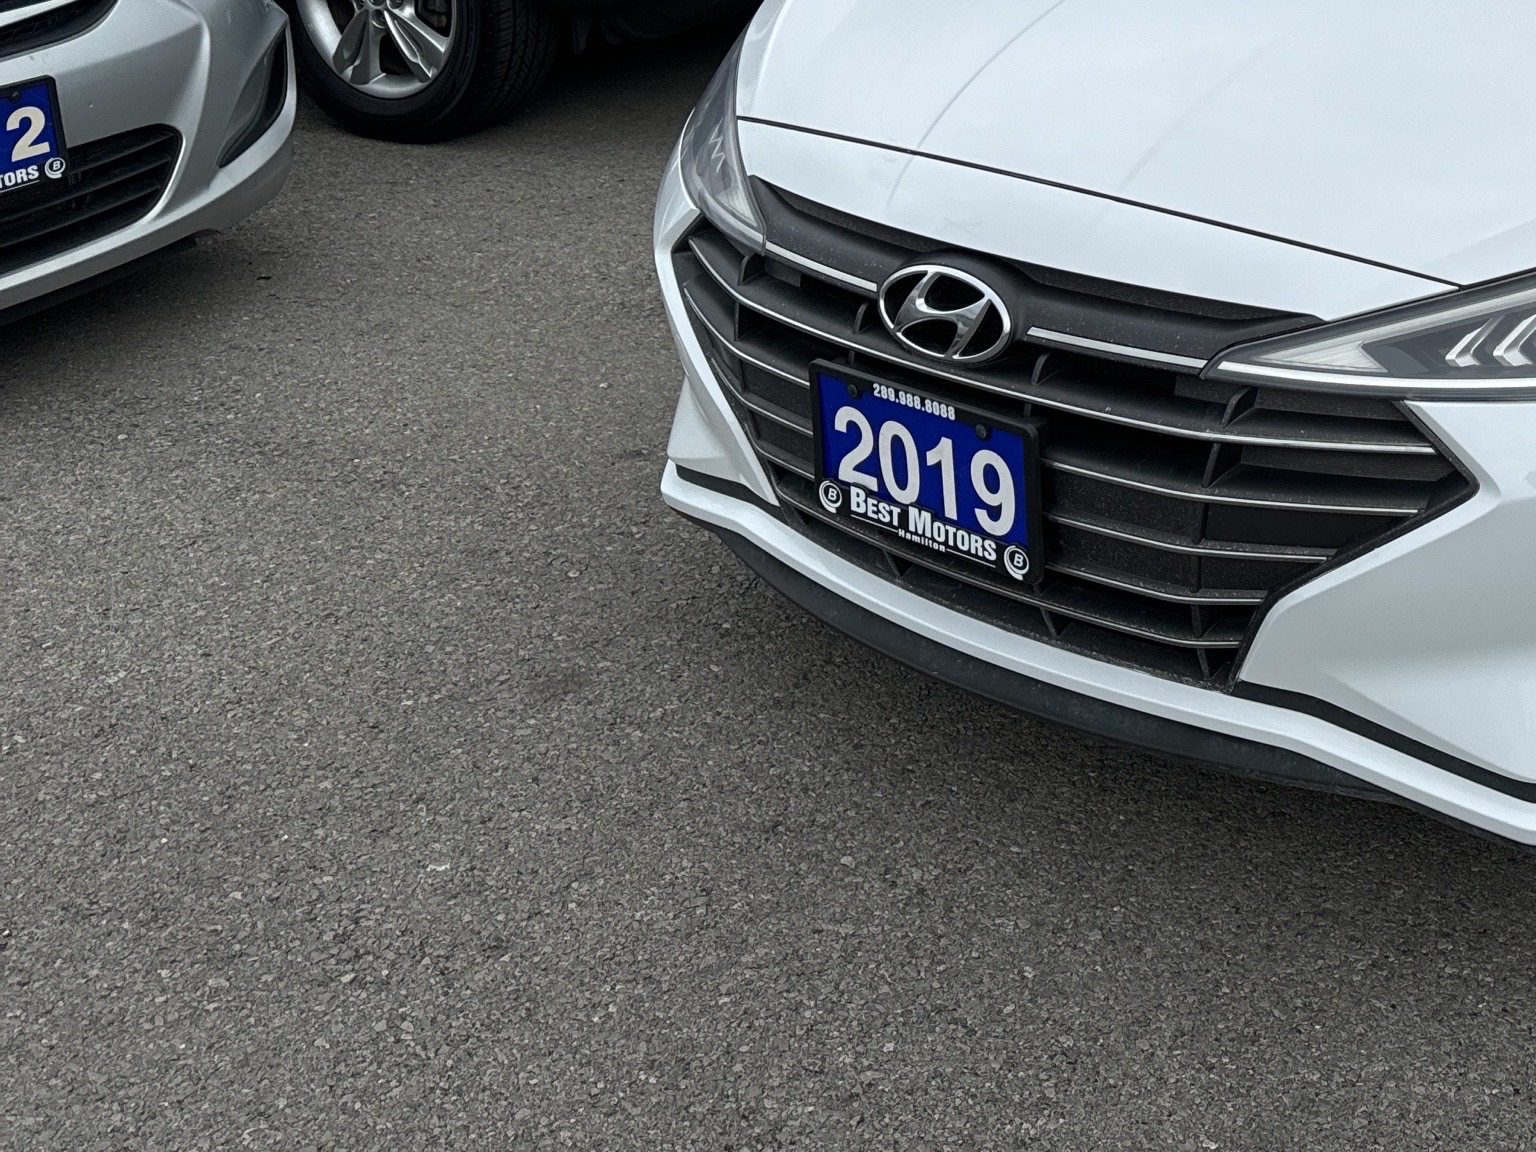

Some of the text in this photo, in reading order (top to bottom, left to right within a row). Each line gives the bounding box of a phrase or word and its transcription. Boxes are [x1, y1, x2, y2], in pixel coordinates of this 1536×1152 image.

[5, 106, 51, 162] 2
[872, 383, 956, 421] 289.988.8088
[834, 405, 1016, 537] 2019
[850, 486, 901, 527] BEST
[908, 505, 997, 561] MOTORS
[898, 528, 946, 553] Hamilton
